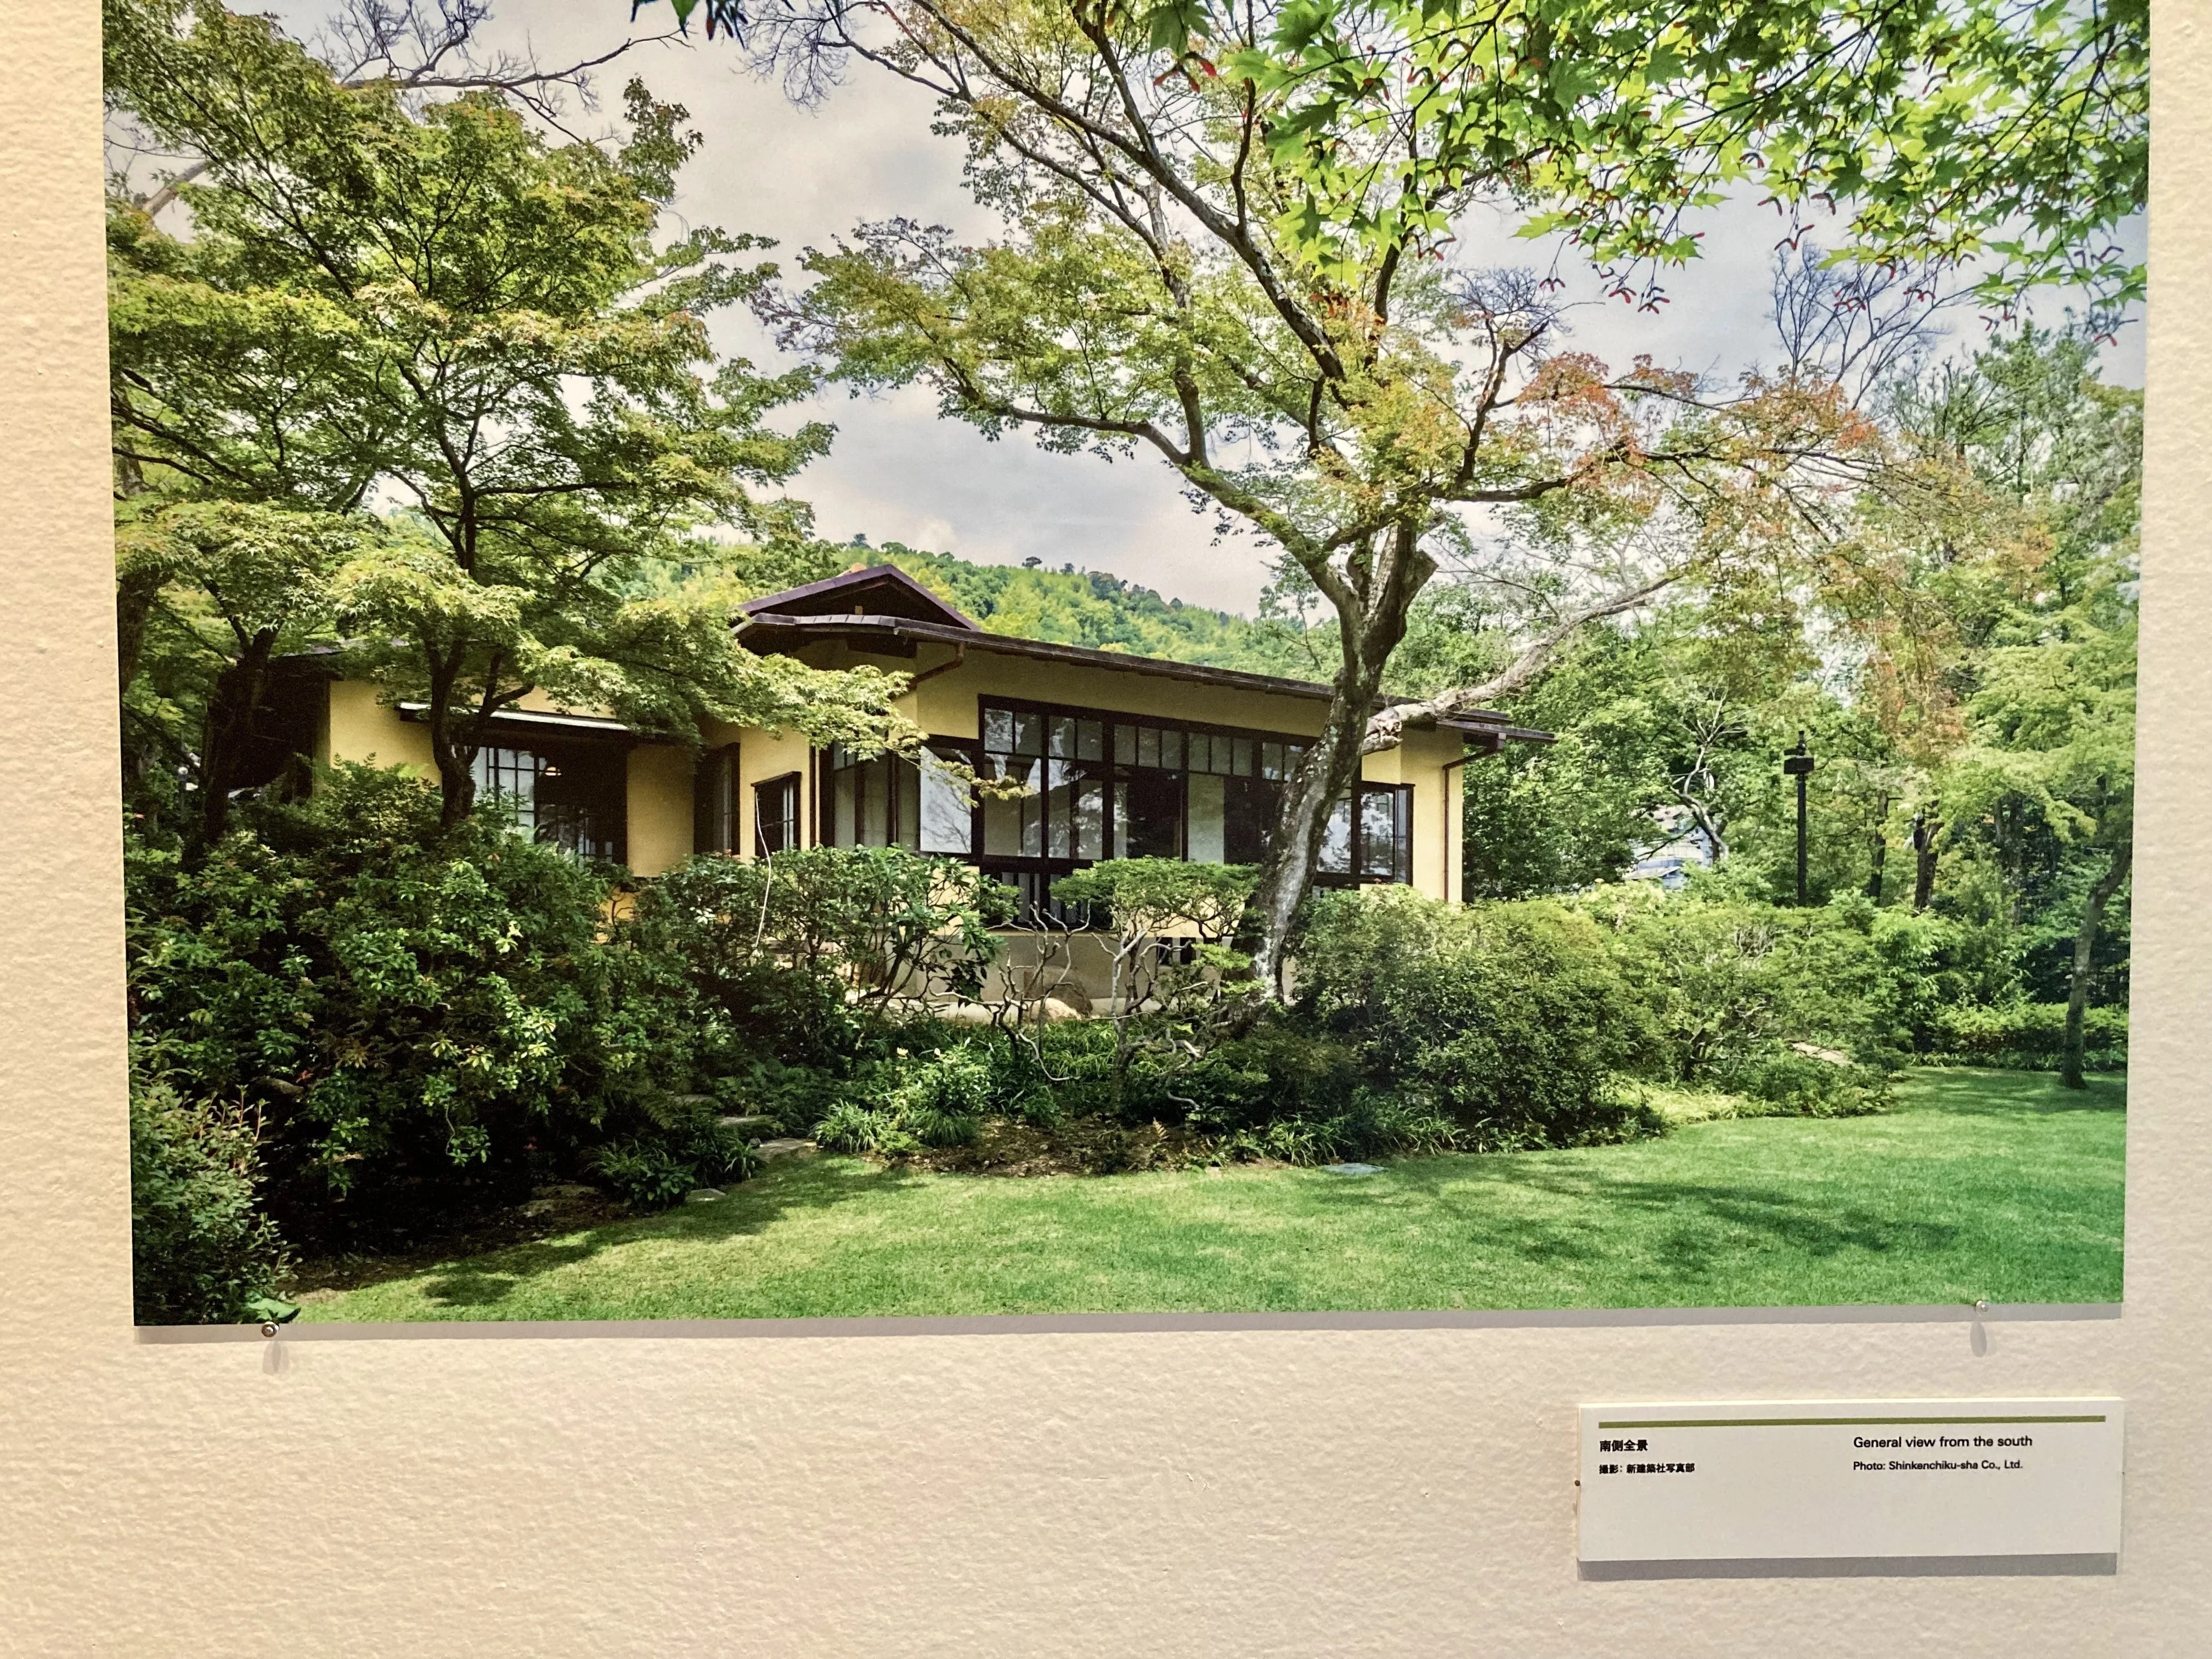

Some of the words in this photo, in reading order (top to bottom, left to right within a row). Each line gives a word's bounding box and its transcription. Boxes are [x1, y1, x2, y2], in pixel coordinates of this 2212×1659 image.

[1599, 1440, 1649, 1452] 南側全景
[1853, 1436, 1902, 1448] General
[1905, 1436, 1936, 1447] view
[1939, 1436, 1970, 1447] from
[1973, 1436, 1994, 1447] the
[1997, 1435, 2033, 1447] south
[1853, 1461, 1886, 1470] Photo:
[1888, 1460, 1978, 1470] Shinkenchiku-sha
[1981, 1460, 2001, 1470] Co.,
[2004, 1459, 2023, 1469] Ltd.
